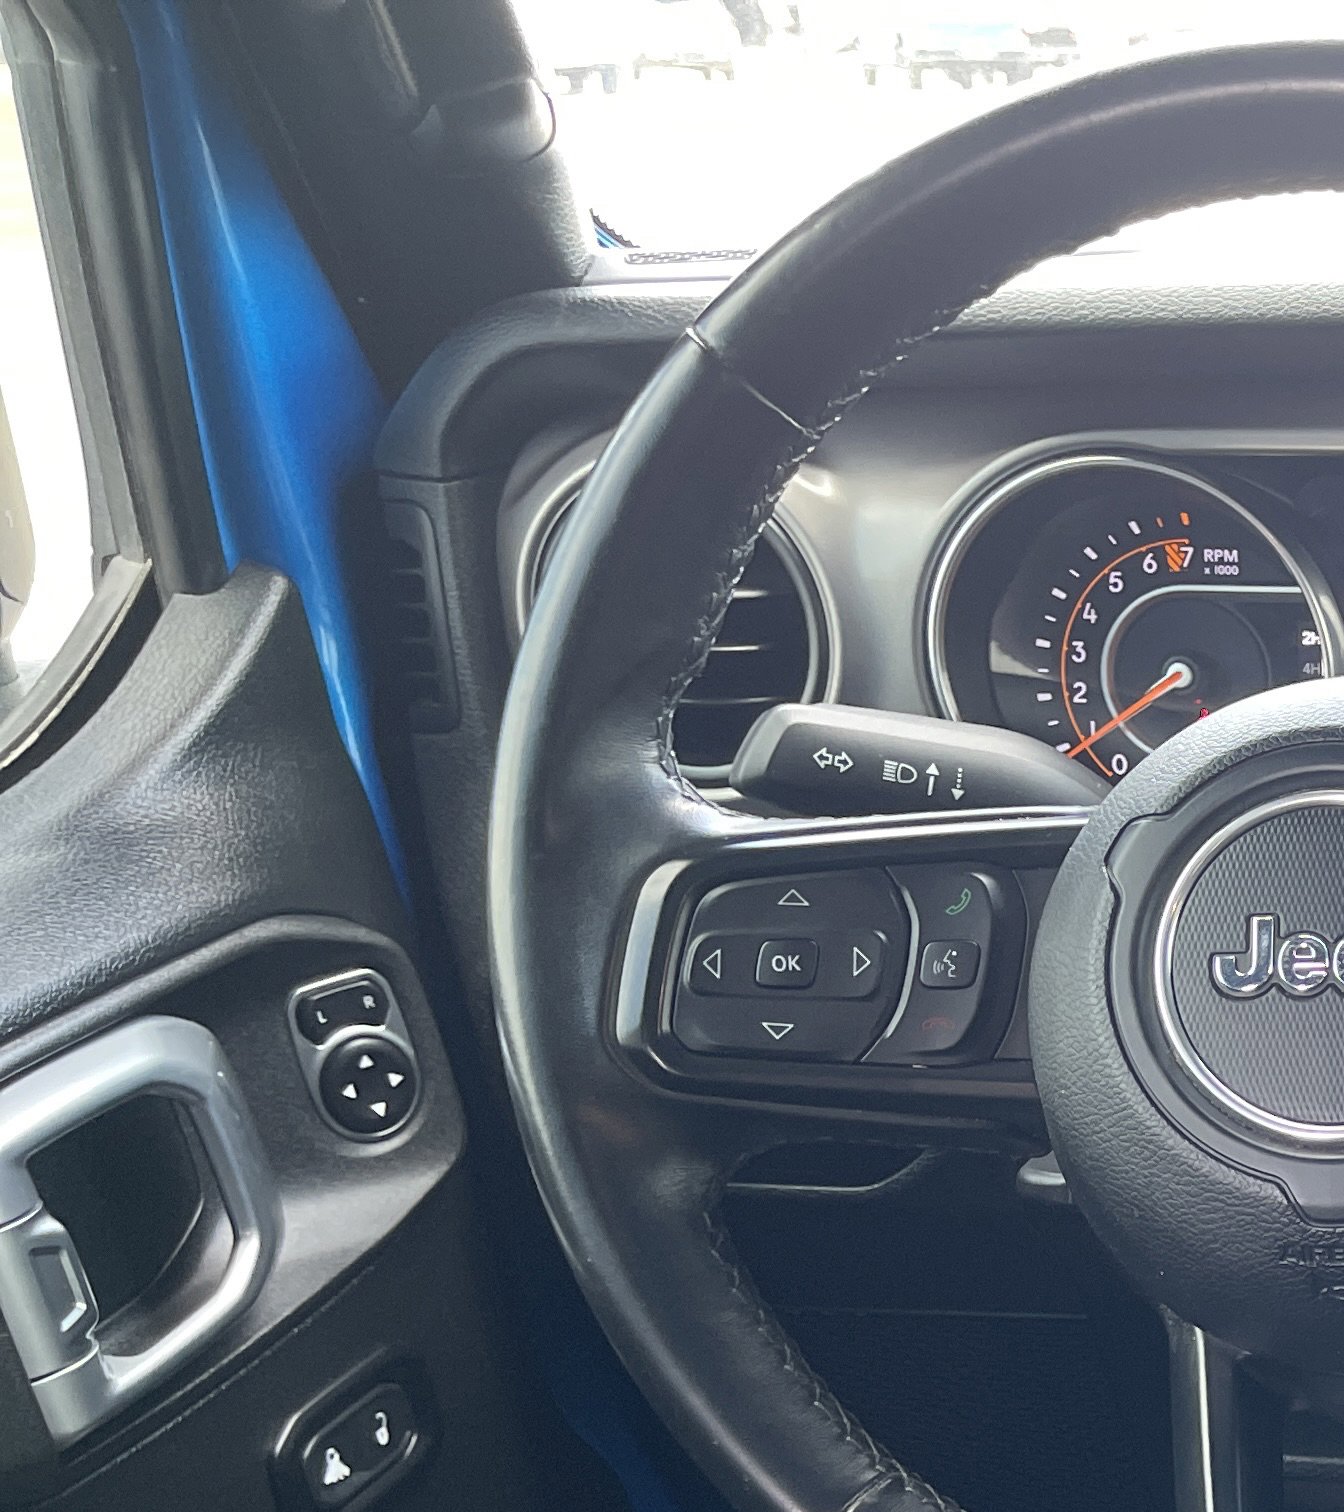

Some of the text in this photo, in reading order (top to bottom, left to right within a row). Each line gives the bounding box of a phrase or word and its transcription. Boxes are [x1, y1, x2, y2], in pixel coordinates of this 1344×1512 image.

[1142, 553, 1159, 574] 6
[1178, 546, 1194, 568] 7
[1203, 548, 1239, 563] RPM
[1214, 564, 1240, 576] 1000
[1107, 571, 1125, 594] 5
[1081, 602, 1099, 624] 4
[1070, 641, 1087, 663] 3
[1072, 682, 1088, 703] 2
[1111, 753, 1129, 776] 0
[771, 953, 802, 973] OK
[362, 995, 376, 1009] R
